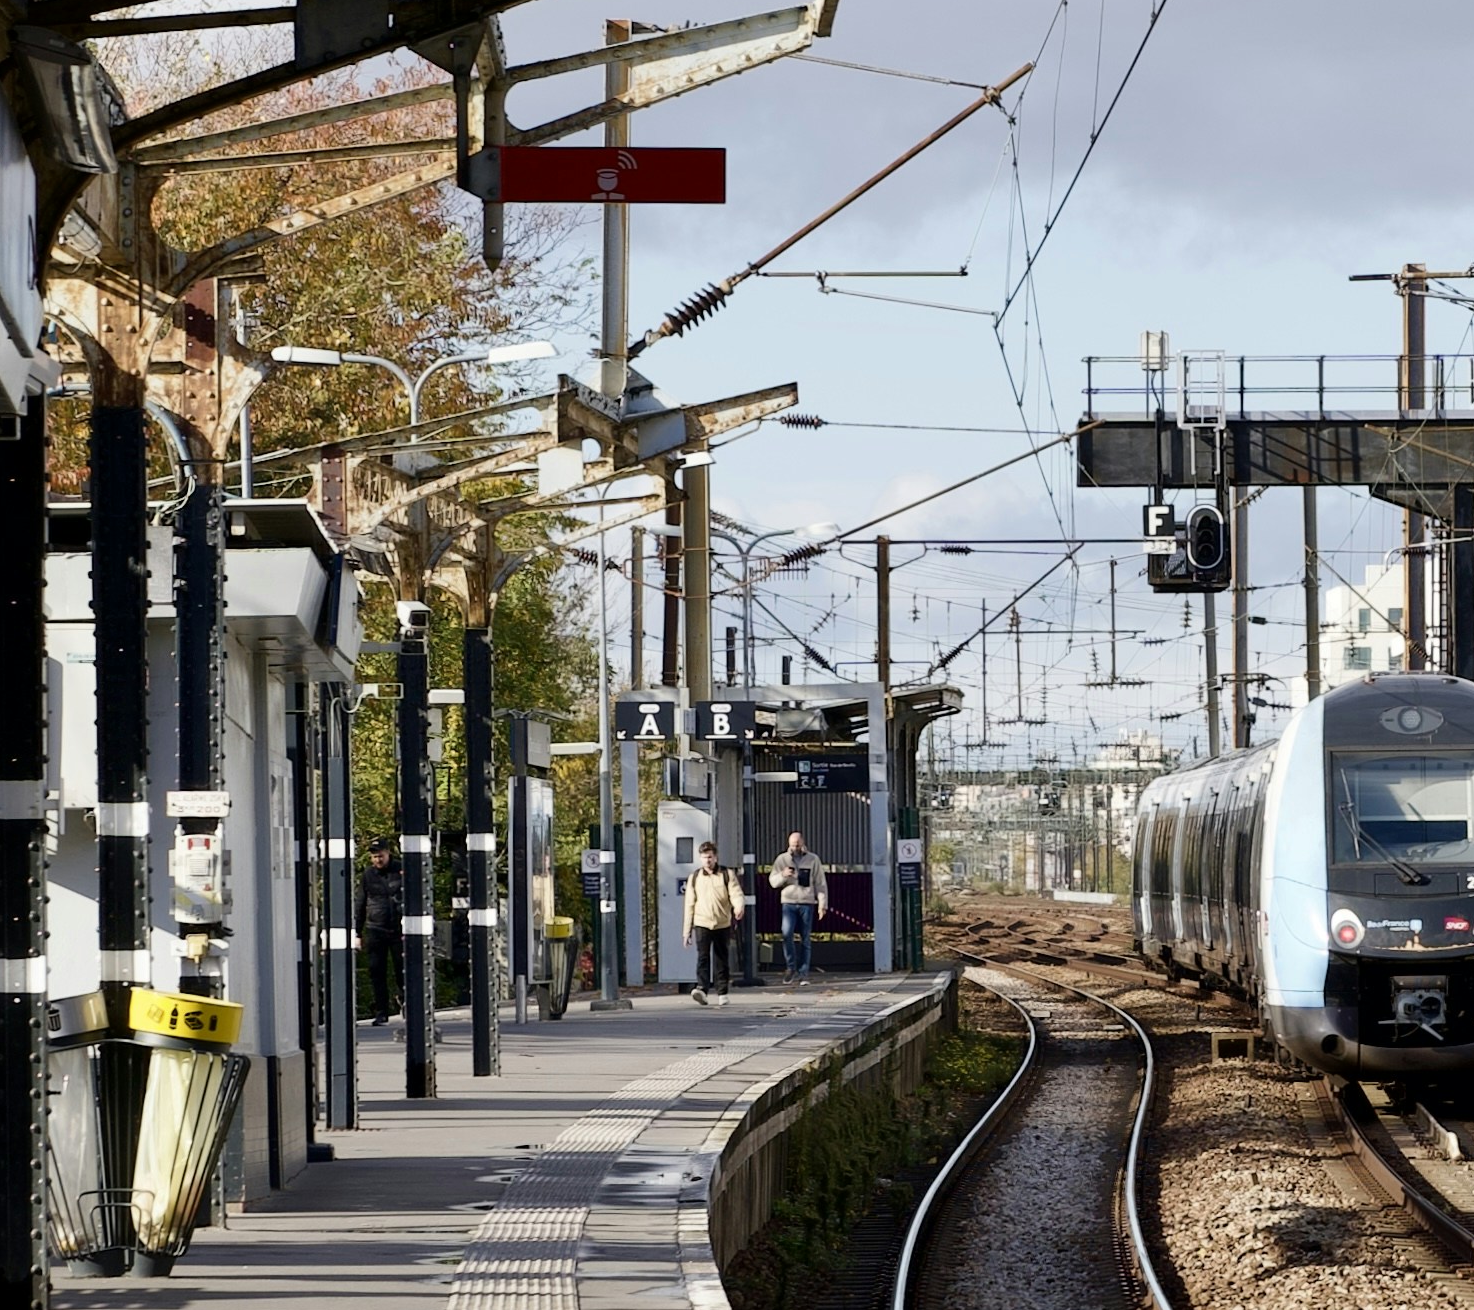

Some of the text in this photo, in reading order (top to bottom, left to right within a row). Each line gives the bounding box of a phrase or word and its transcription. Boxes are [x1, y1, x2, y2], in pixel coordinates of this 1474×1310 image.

[1148, 505, 1170, 536] F
[640, 714, 660, 735] A
[712, 713, 731, 735] B
